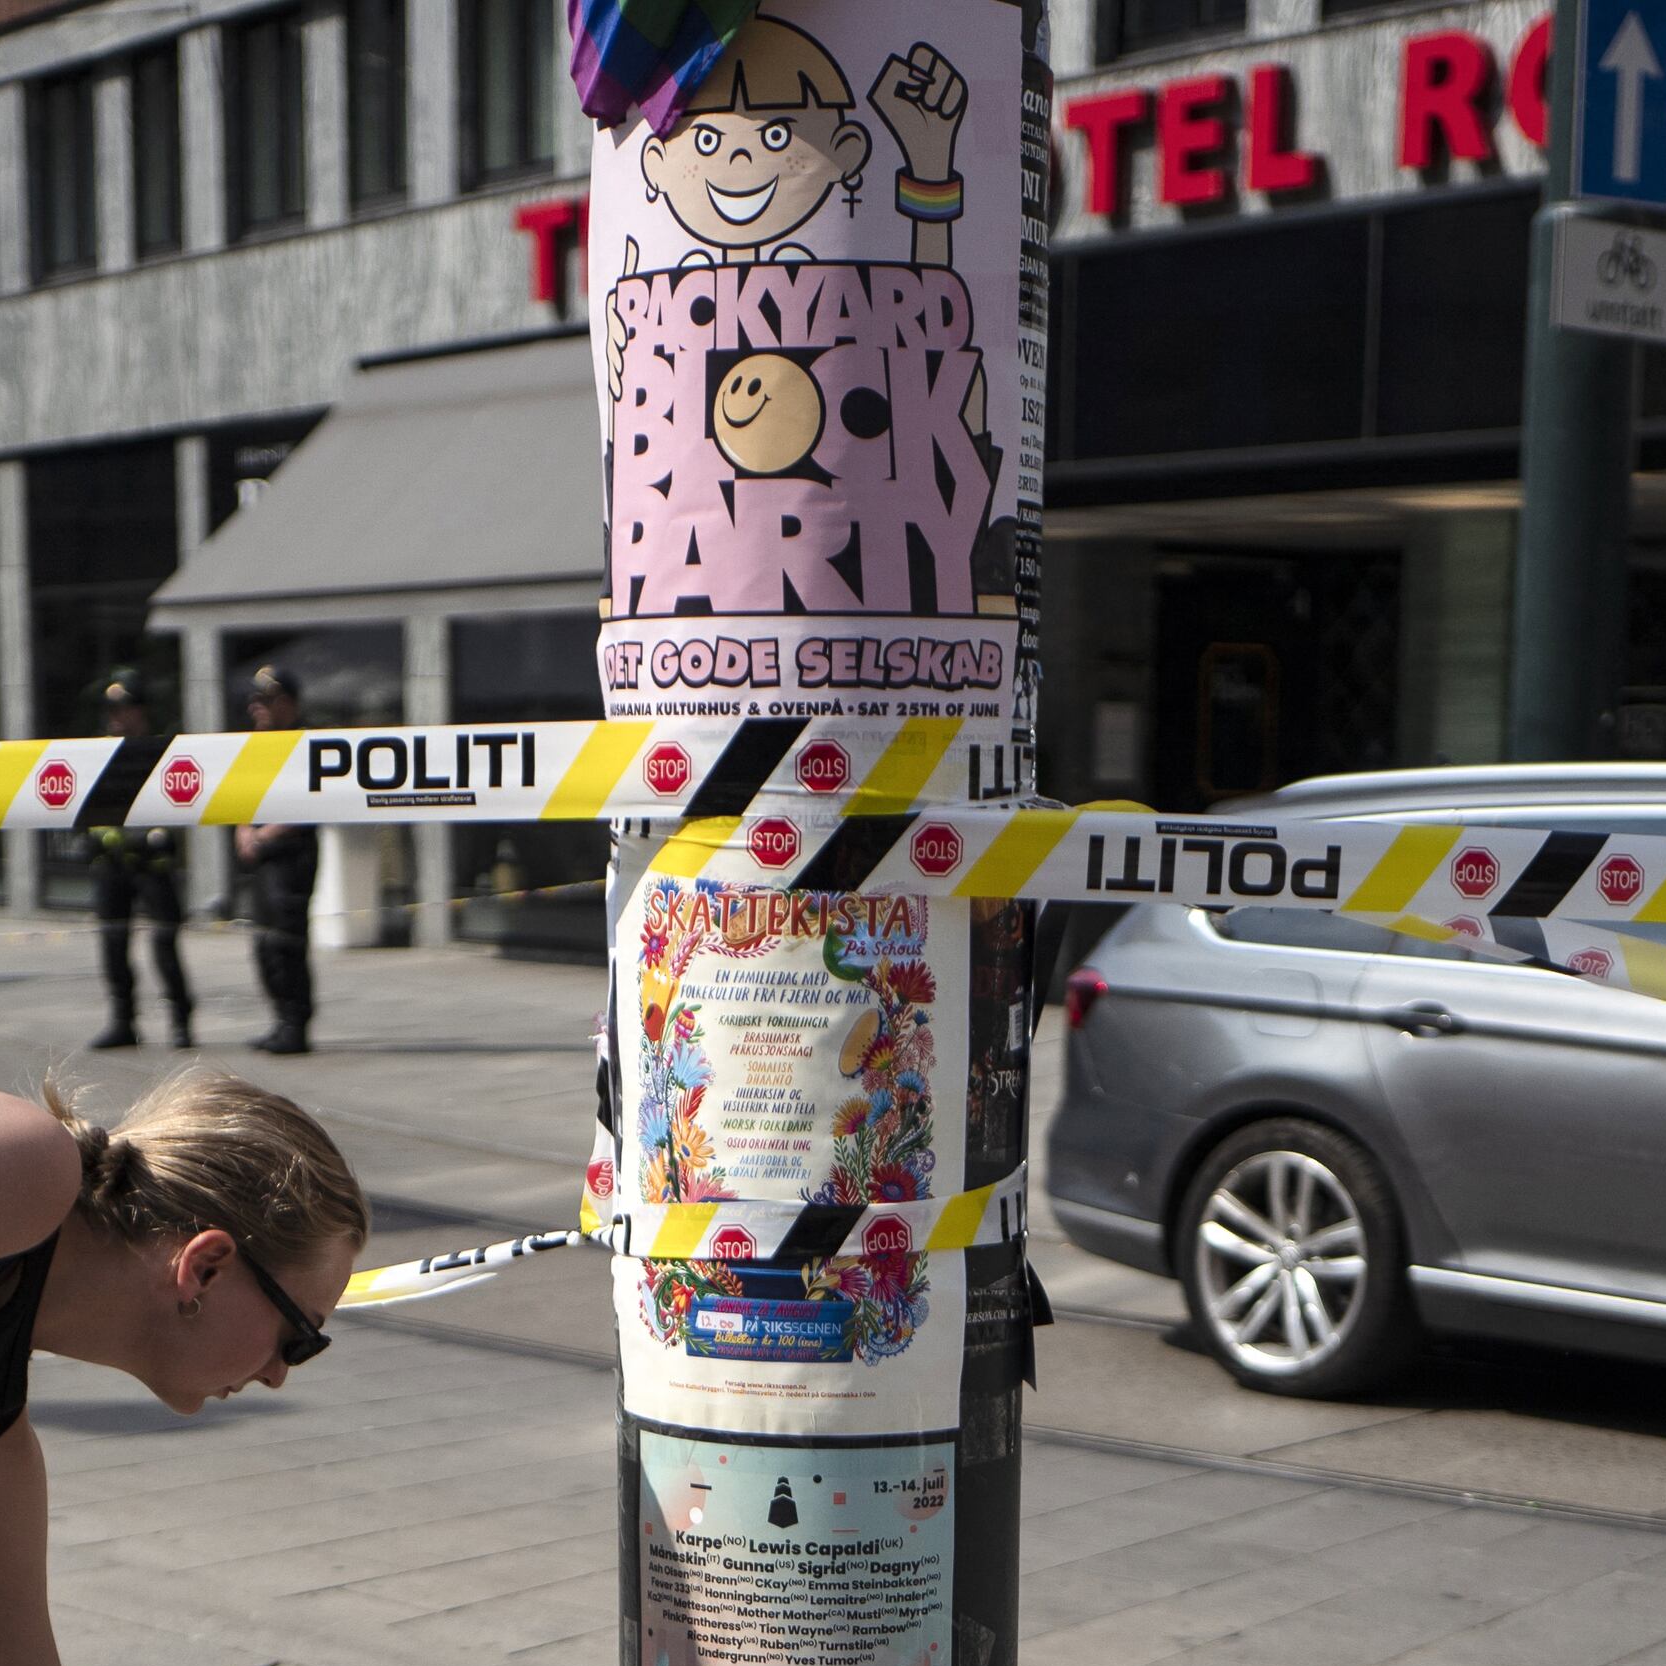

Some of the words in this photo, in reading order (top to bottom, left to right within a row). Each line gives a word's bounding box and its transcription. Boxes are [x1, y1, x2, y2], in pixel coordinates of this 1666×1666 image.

[1061, 64, 1316, 216] TEL
[617, 264, 975, 354] BACKYARD
[613, 346, 993, 490] BLOCK
[612, 476, 993, 616] PARTY
[604, 640, 643, 692] DET
[650, 634, 781, 690] GODE
[795, 635, 1003, 692] SELSKAB
[656, 701, 741, 717] KULTURHUS
[747, 701, 761, 717] &
[768, 697, 844, 717] OVENPÅ
[857, 701, 890, 717] SAT
[896, 701, 940, 718] 25TH
[945, 701, 965, 718] OF
[968, 702, 1000, 718] JUNE
[308, 730, 536, 793] POLITI
[648, 760, 687, 781] STOP
[801, 756, 845, 778] STOP
[39, 775, 73, 795] STOP
[165, 770, 200, 793] STOP
[751, 830, 796, 854] STOP
[915, 837, 958, 860] STOP
[1086, 834, 1342, 900] POLITI
[1455, 863, 1495, 883] STOP
[1601, 870, 1639, 890] STOP
[648, 888, 912, 937] SKATTEKISTA
[844, 937, 867, 958] På
[874, 940, 923, 957] Schous
[715, 968, 730, 984] EN
[733, 969, 798, 986] FAMILIEDAG
[801, 971, 829, 986] MED
[680, 984, 750, 1000] FOLKEKULTUR
[753, 986, 776, 1004] FRA
[779, 988, 820, 1004] FJERN
[824, 991, 841, 1004] OG
[845, 990, 872, 1005] NÆR
[789, 1088, 803, 1100] OG
[771, 1102, 792, 1114] MED
[794, 1103, 816, 1115] FELA
[723, 1118, 756, 1131] NORSK
[758, 1119, 814, 1132] FOLKEDANS
[726, 1136, 747, 1149] OSLO
[792, 1140, 811, 1151] UNG
[790, 1155, 803, 1167] OG
[868, 1228, 908, 1251] STOP
[714, 1241, 752, 1259] STOP
[744, 1316, 760, 1332] PÅ
[761, 1320, 842, 1335] RIKSSCENEN
[777, 1334, 796, 1347] 100
[922, 1475, 945, 1492] juli
[913, 1495, 945, 1510] 2022
[749, 1539, 802, 1555] Lewis
[651, 1576, 673, 1591] Fever
[808, 1580, 850, 1591] Emma
[737, 1606, 781, 1620] Mother
[687, 1629, 709, 1642] Rico
[759, 1623, 786, 1635] Tion
[784, 1654, 816, 1666] Yves
